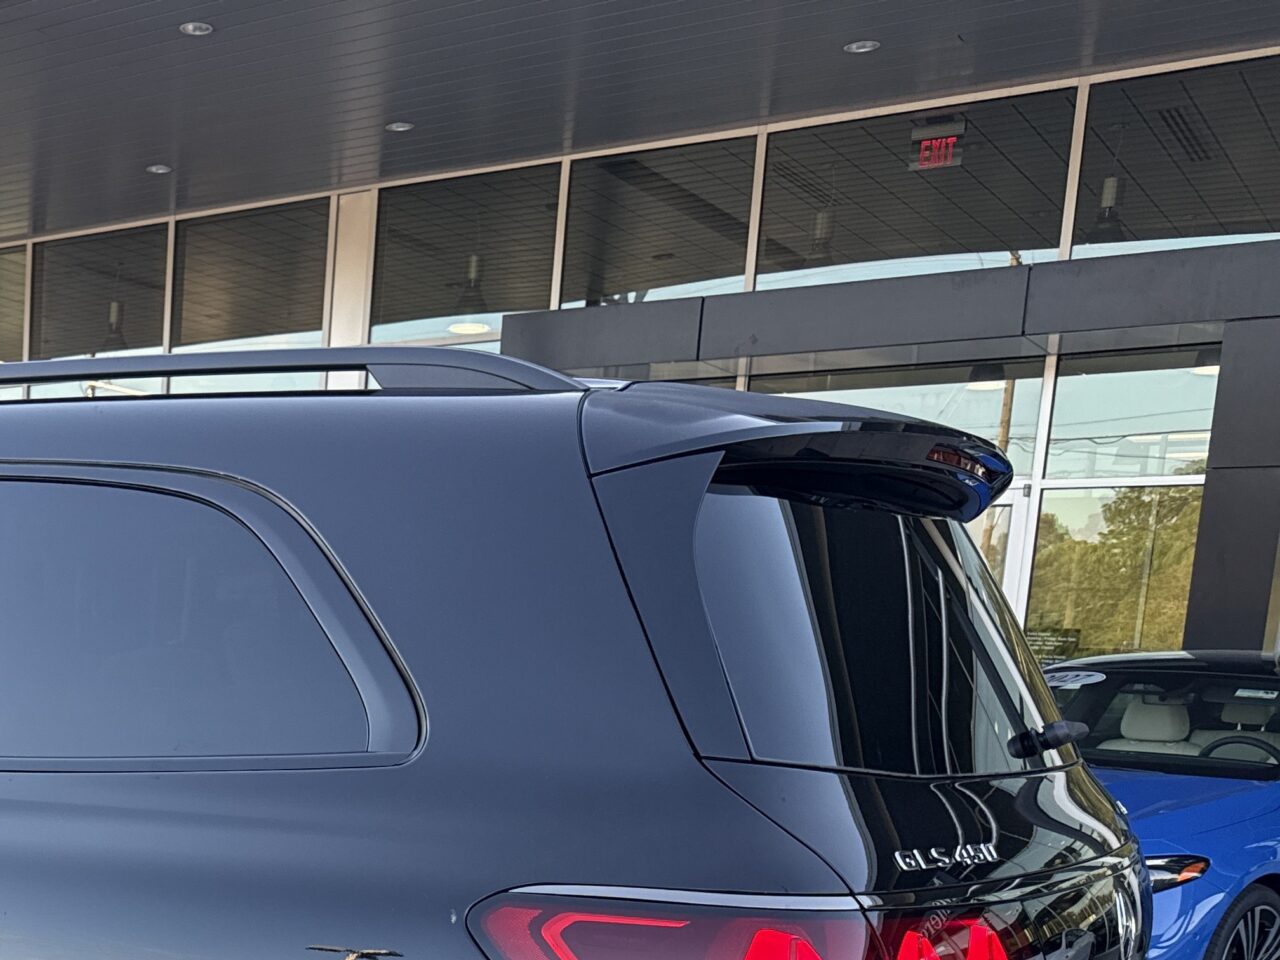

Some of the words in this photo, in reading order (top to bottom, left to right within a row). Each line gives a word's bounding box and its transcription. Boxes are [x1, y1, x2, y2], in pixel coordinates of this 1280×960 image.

[919, 137, 957, 168] EXIT
[894, 847, 953, 871] GLS
[954, 843, 998, 865] 450
